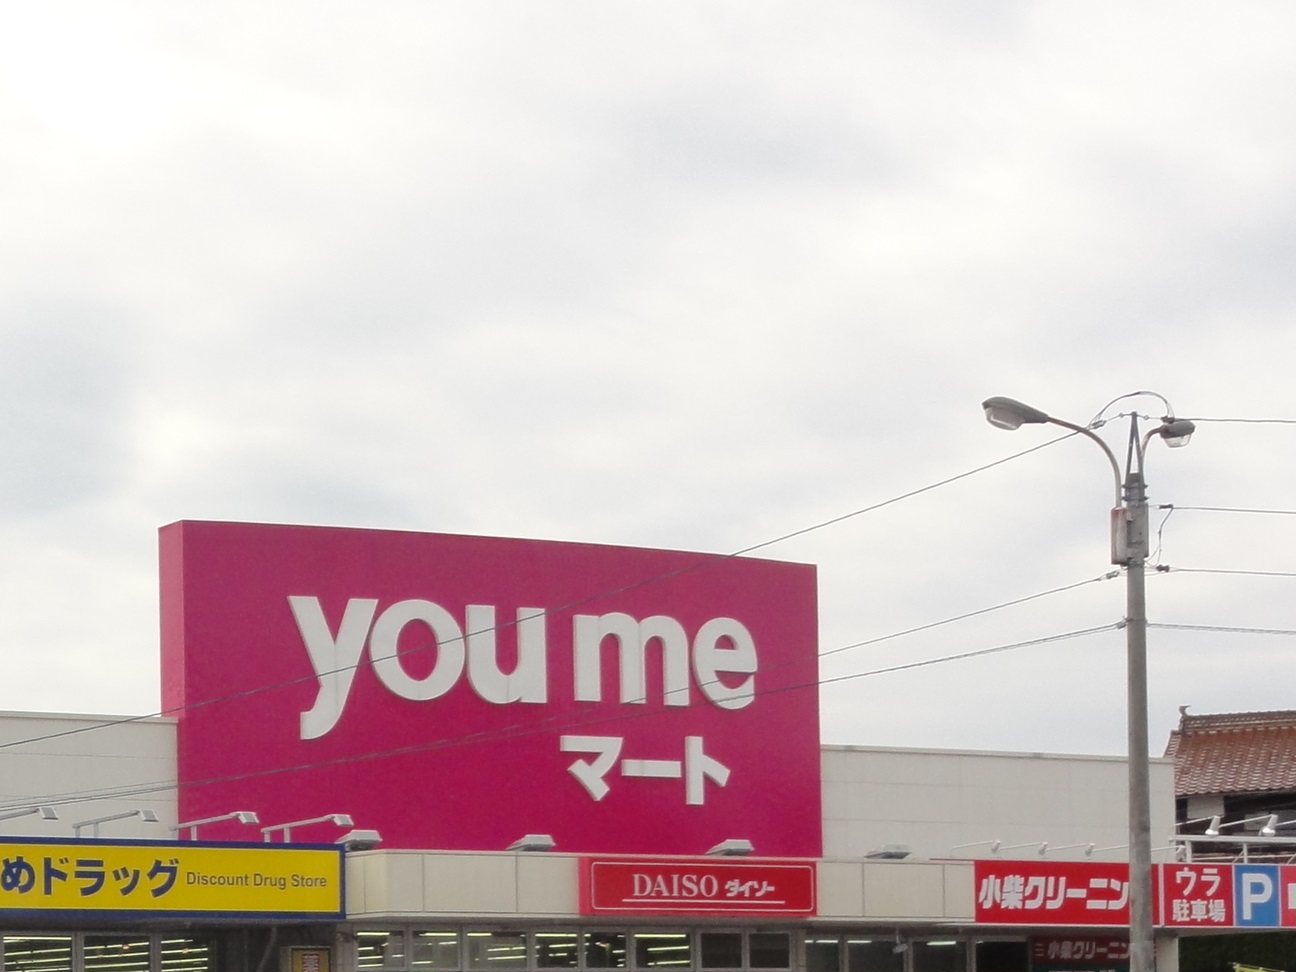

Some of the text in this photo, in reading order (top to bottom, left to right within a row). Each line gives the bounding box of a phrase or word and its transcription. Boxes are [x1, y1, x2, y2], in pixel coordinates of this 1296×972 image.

[560, 735, 731, 805] マート
[186, 871, 327, 890] Discount Drug Store
[632, 873, 775, 898] DAISO ダイソー
[978, 874, 1130, 910] 小柴クリーニン
[1175, 867, 1221, 896] ウラ
[1242, 873, 1273, 920] P
[1172, 899, 1226, 922] 駐車場
[1047, 941, 1130, 959] 小柴クリーニン
